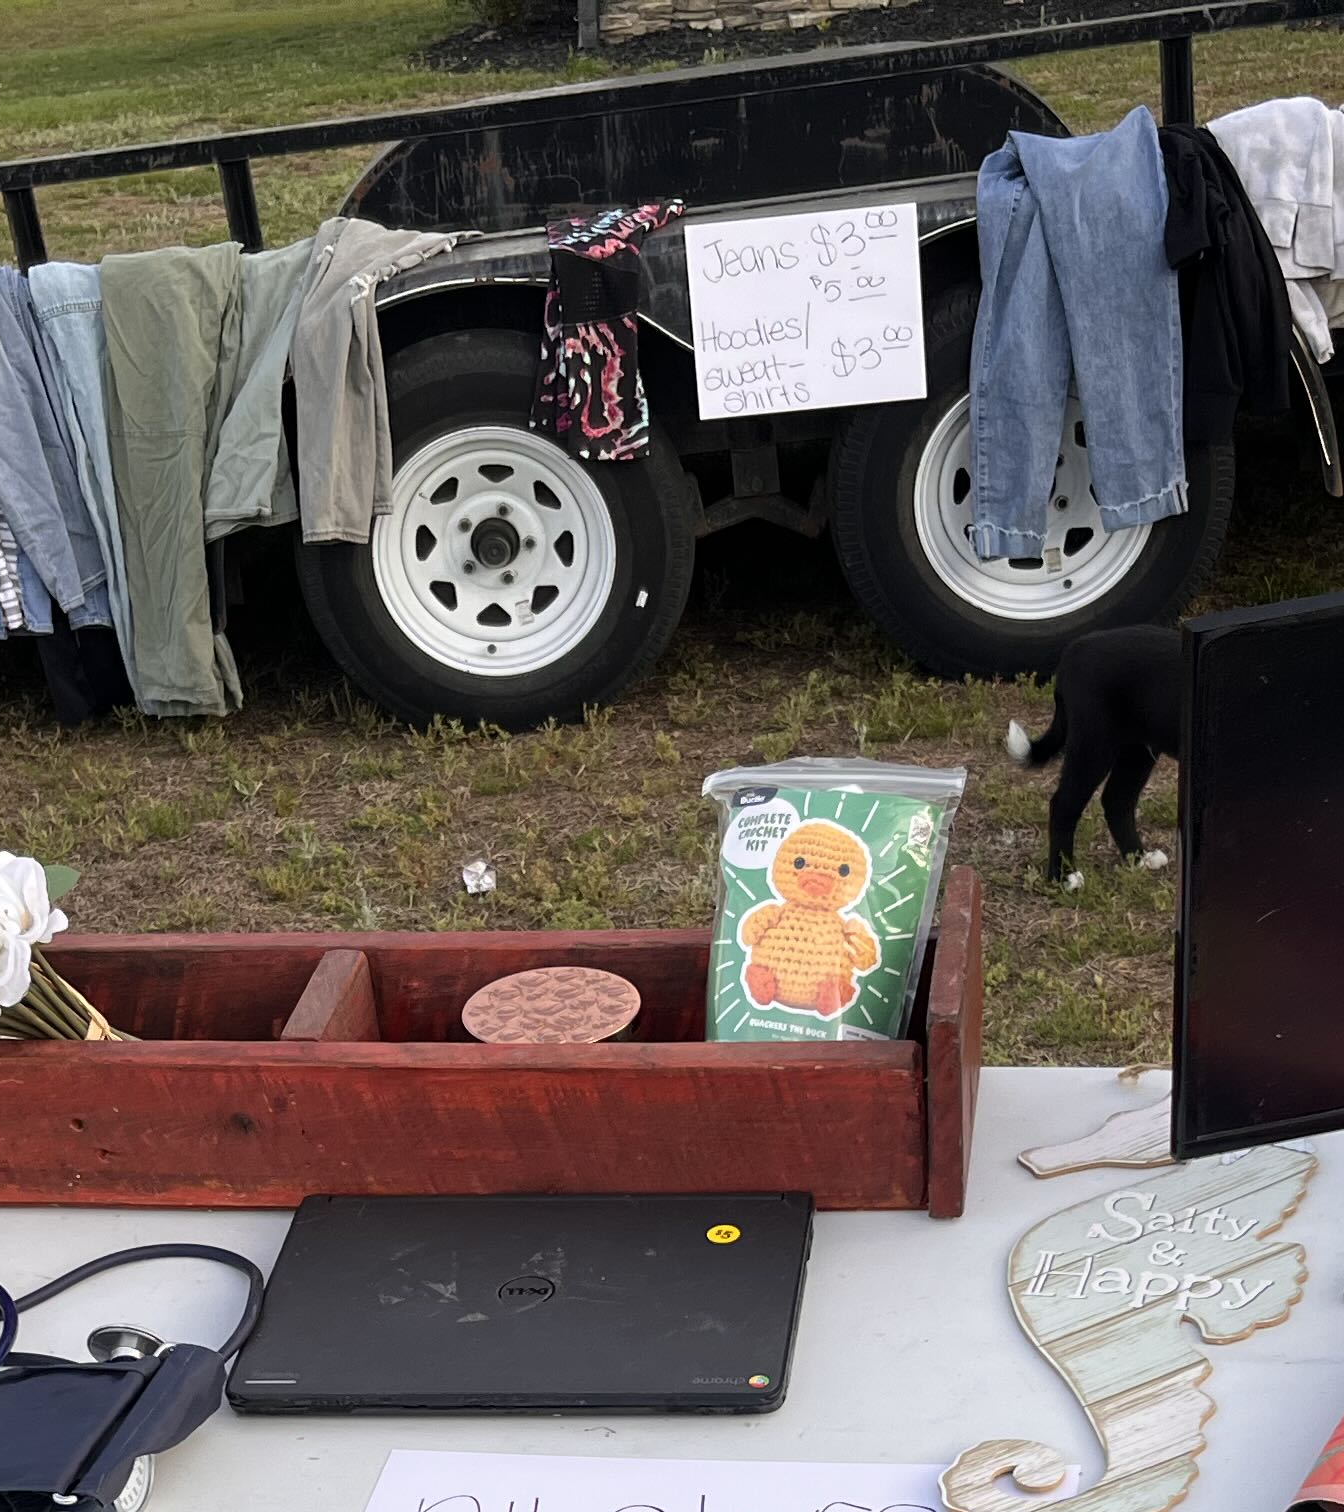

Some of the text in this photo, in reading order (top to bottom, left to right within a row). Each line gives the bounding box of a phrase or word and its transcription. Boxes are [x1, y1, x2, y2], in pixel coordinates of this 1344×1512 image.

[702, 238, 800, 284] Jeans
[704, 355, 804, 391] sweat-
[723, 382, 810, 413] shirts
[738, 813, 792, 829] COMPLETE
[738, 826, 788, 841] CROCHET
[746, 839, 768, 852] KIT
[789, 1024, 804, 1035] THE
[805, 1027, 827, 1039] DUCK
[1086, 1190, 1260, 1243] Salty
[1147, 1240, 1188, 1267] &
[1021, 1250, 1274, 1311] Happy
[692, 1376, 746, 1385] chrome
